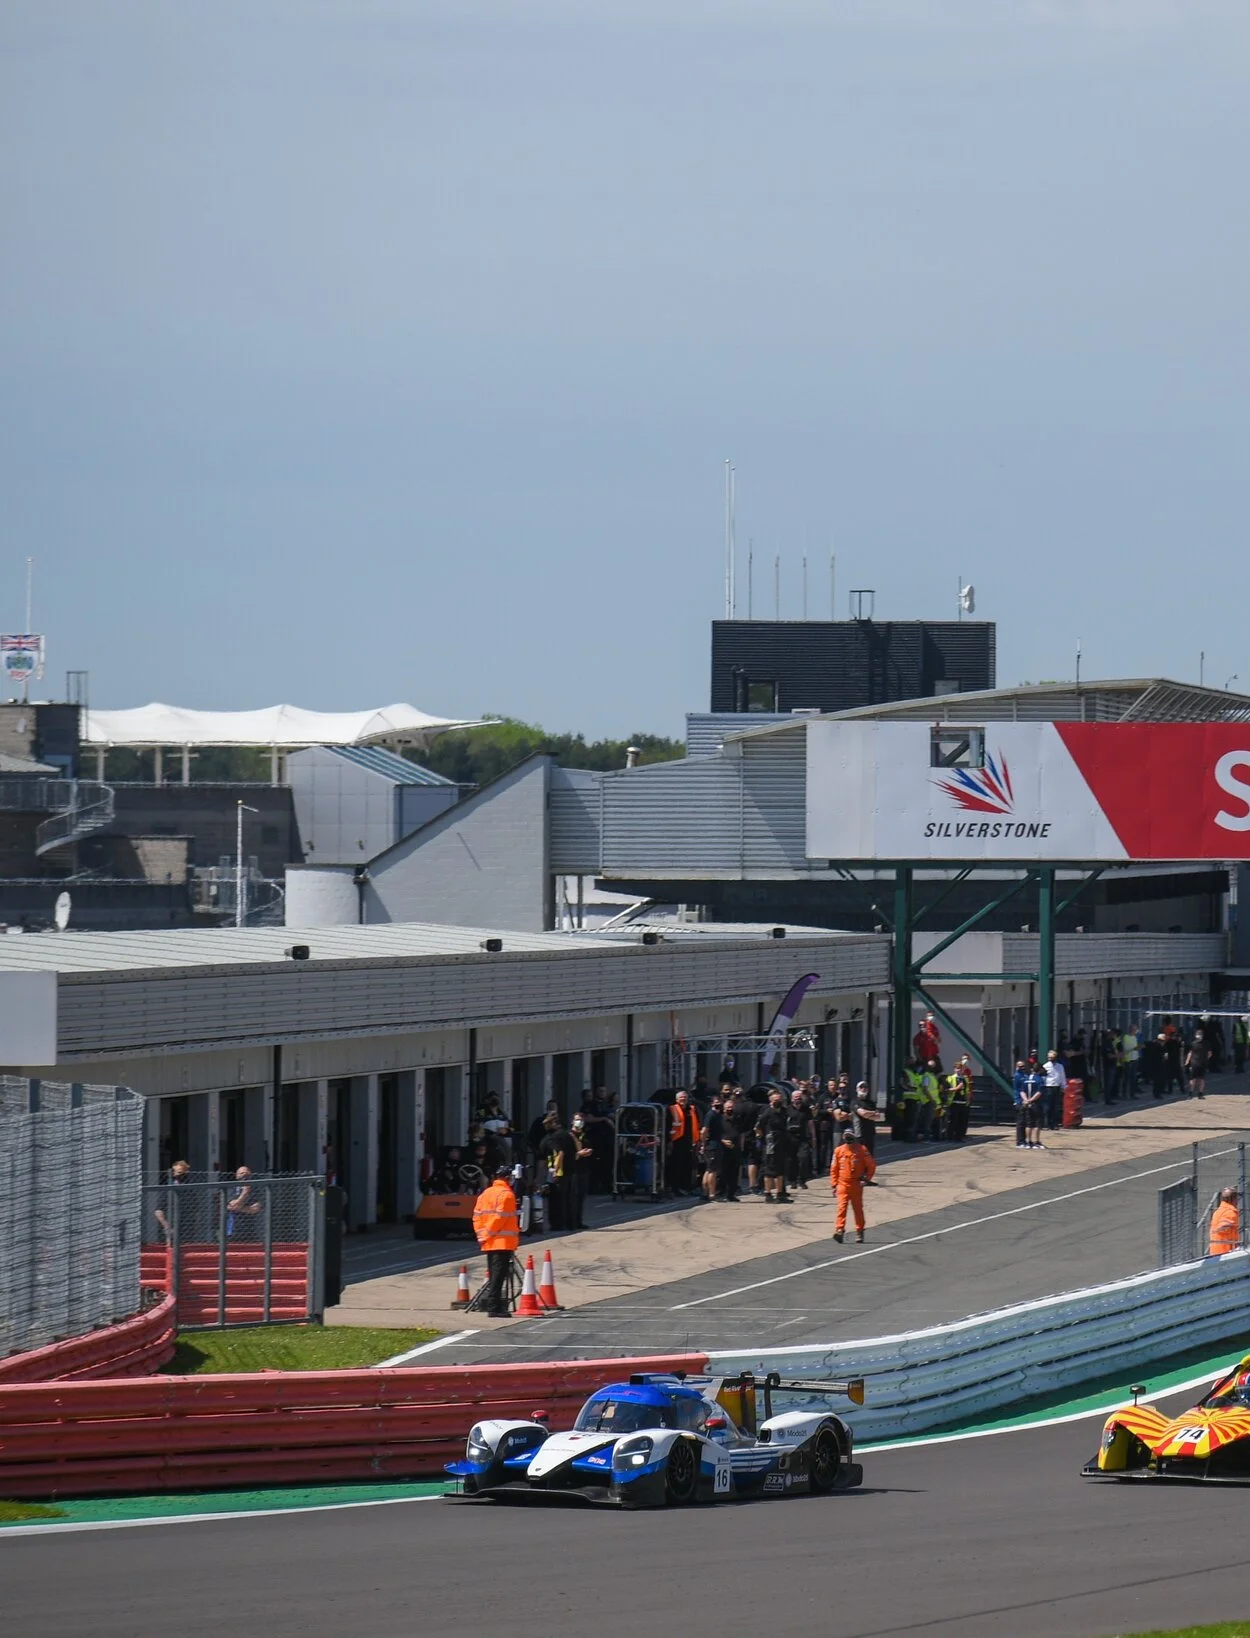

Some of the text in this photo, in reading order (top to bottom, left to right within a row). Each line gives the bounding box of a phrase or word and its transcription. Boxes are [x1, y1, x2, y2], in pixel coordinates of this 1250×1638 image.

[924, 822, 1052, 838] SILVERSTONE
[1178, 1429, 1205, 1440] 74
[716, 1469, 728, 1488] 16
